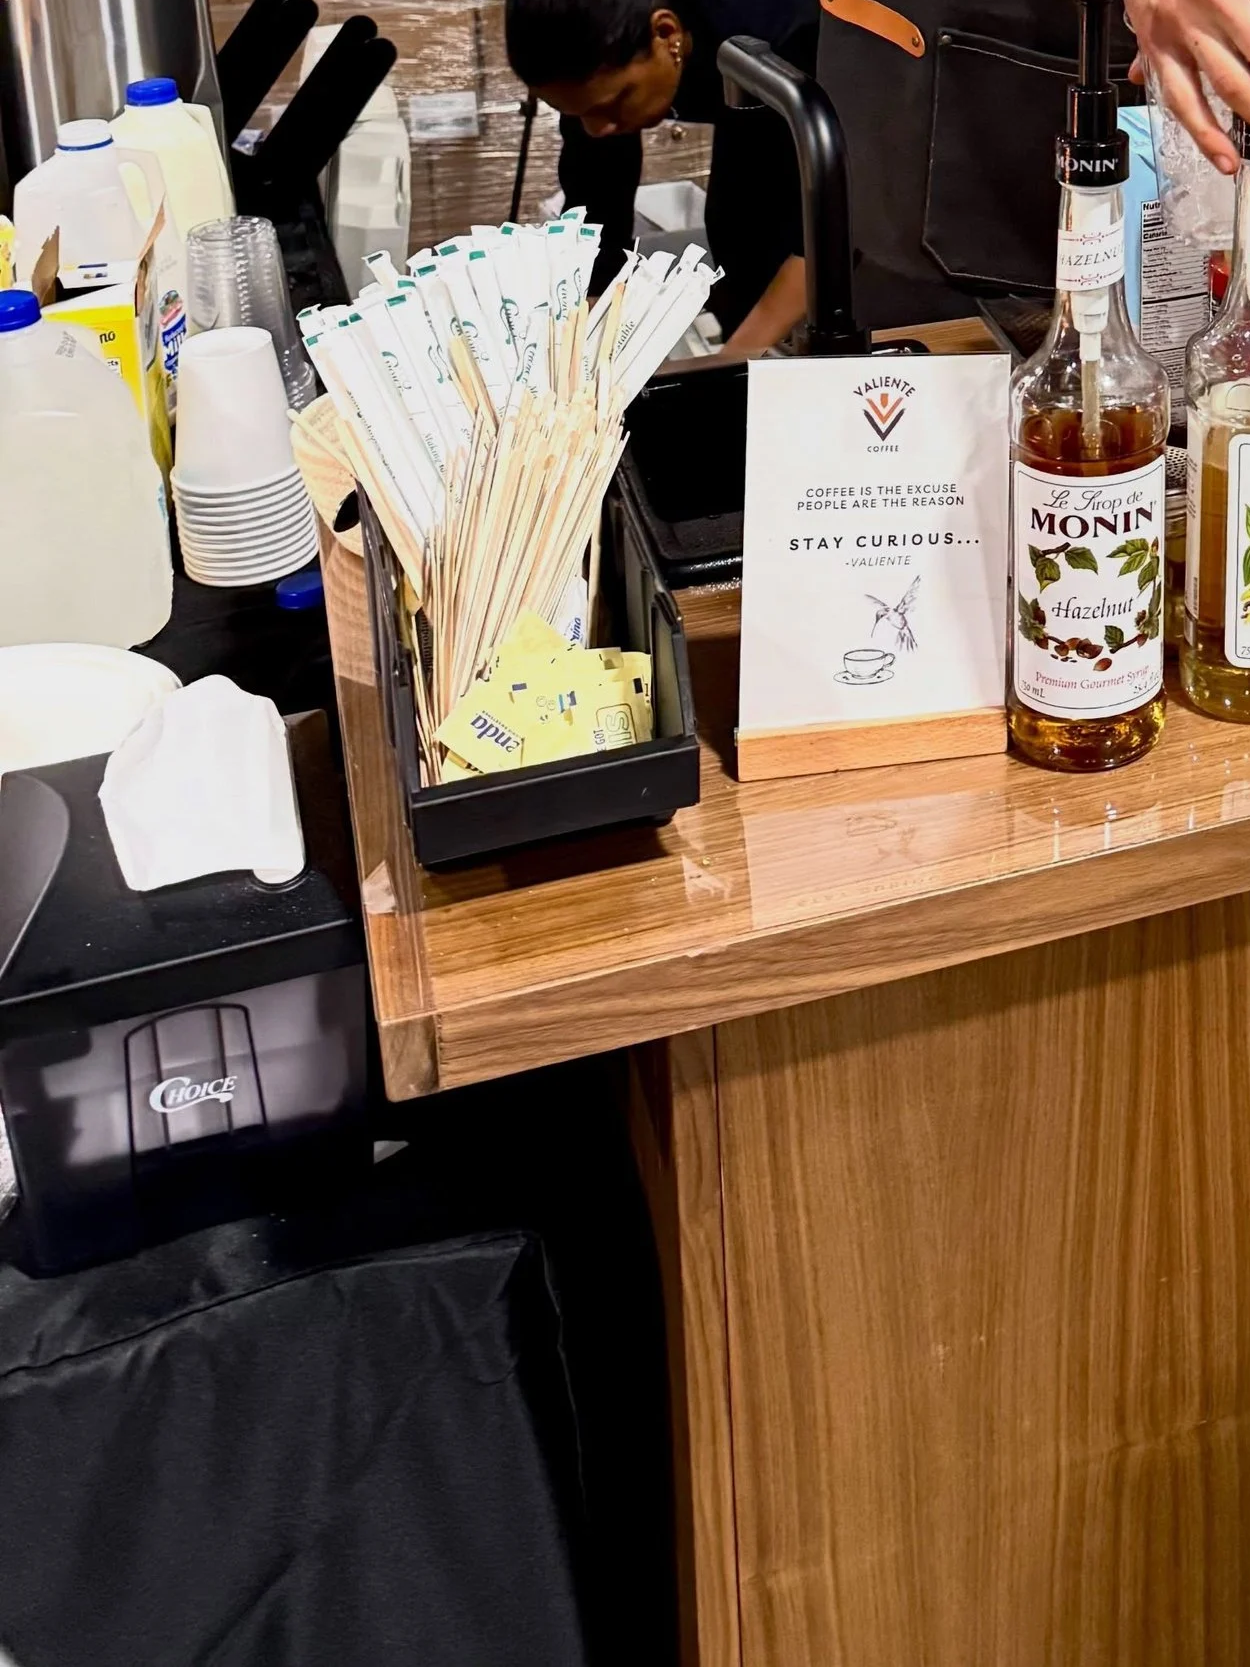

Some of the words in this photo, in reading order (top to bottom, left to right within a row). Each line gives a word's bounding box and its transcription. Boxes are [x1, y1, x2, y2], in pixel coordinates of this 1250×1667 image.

[853, 376, 916, 397] VALIENTE
[867, 445, 899, 453] COFFEE
[806, 486, 855, 498] COFFEE
[860, 486, 872, 496] IS
[877, 485, 902, 496] THE
[907, 484, 957, 494] EXCUSE
[797, 498, 847, 511] PEOPLE
[852, 498, 877, 509] ARE
[882, 497, 907, 508] THE
[912, 495, 965, 506] REASON
[1043, 489, 1070, 510] Le
[1074, 490, 1122, 514] Sirop
[1126, 491, 1143, 506] de
[1030, 502, 1155, 539] MONIN
[789, 536, 844, 551] STAY
[856, 532, 980, 548] CURIOUS...
[845, 555, 912, 567] -VALIENTE
[1051, 596, 1134, 620] Hazelnut
[1035, 671, 1077, 689] Premium
[1080, 673, 1125, 690] Gourmet
[1032, 686, 1046, 699] mL
[149, 1076, 238, 1113] CHOICE
